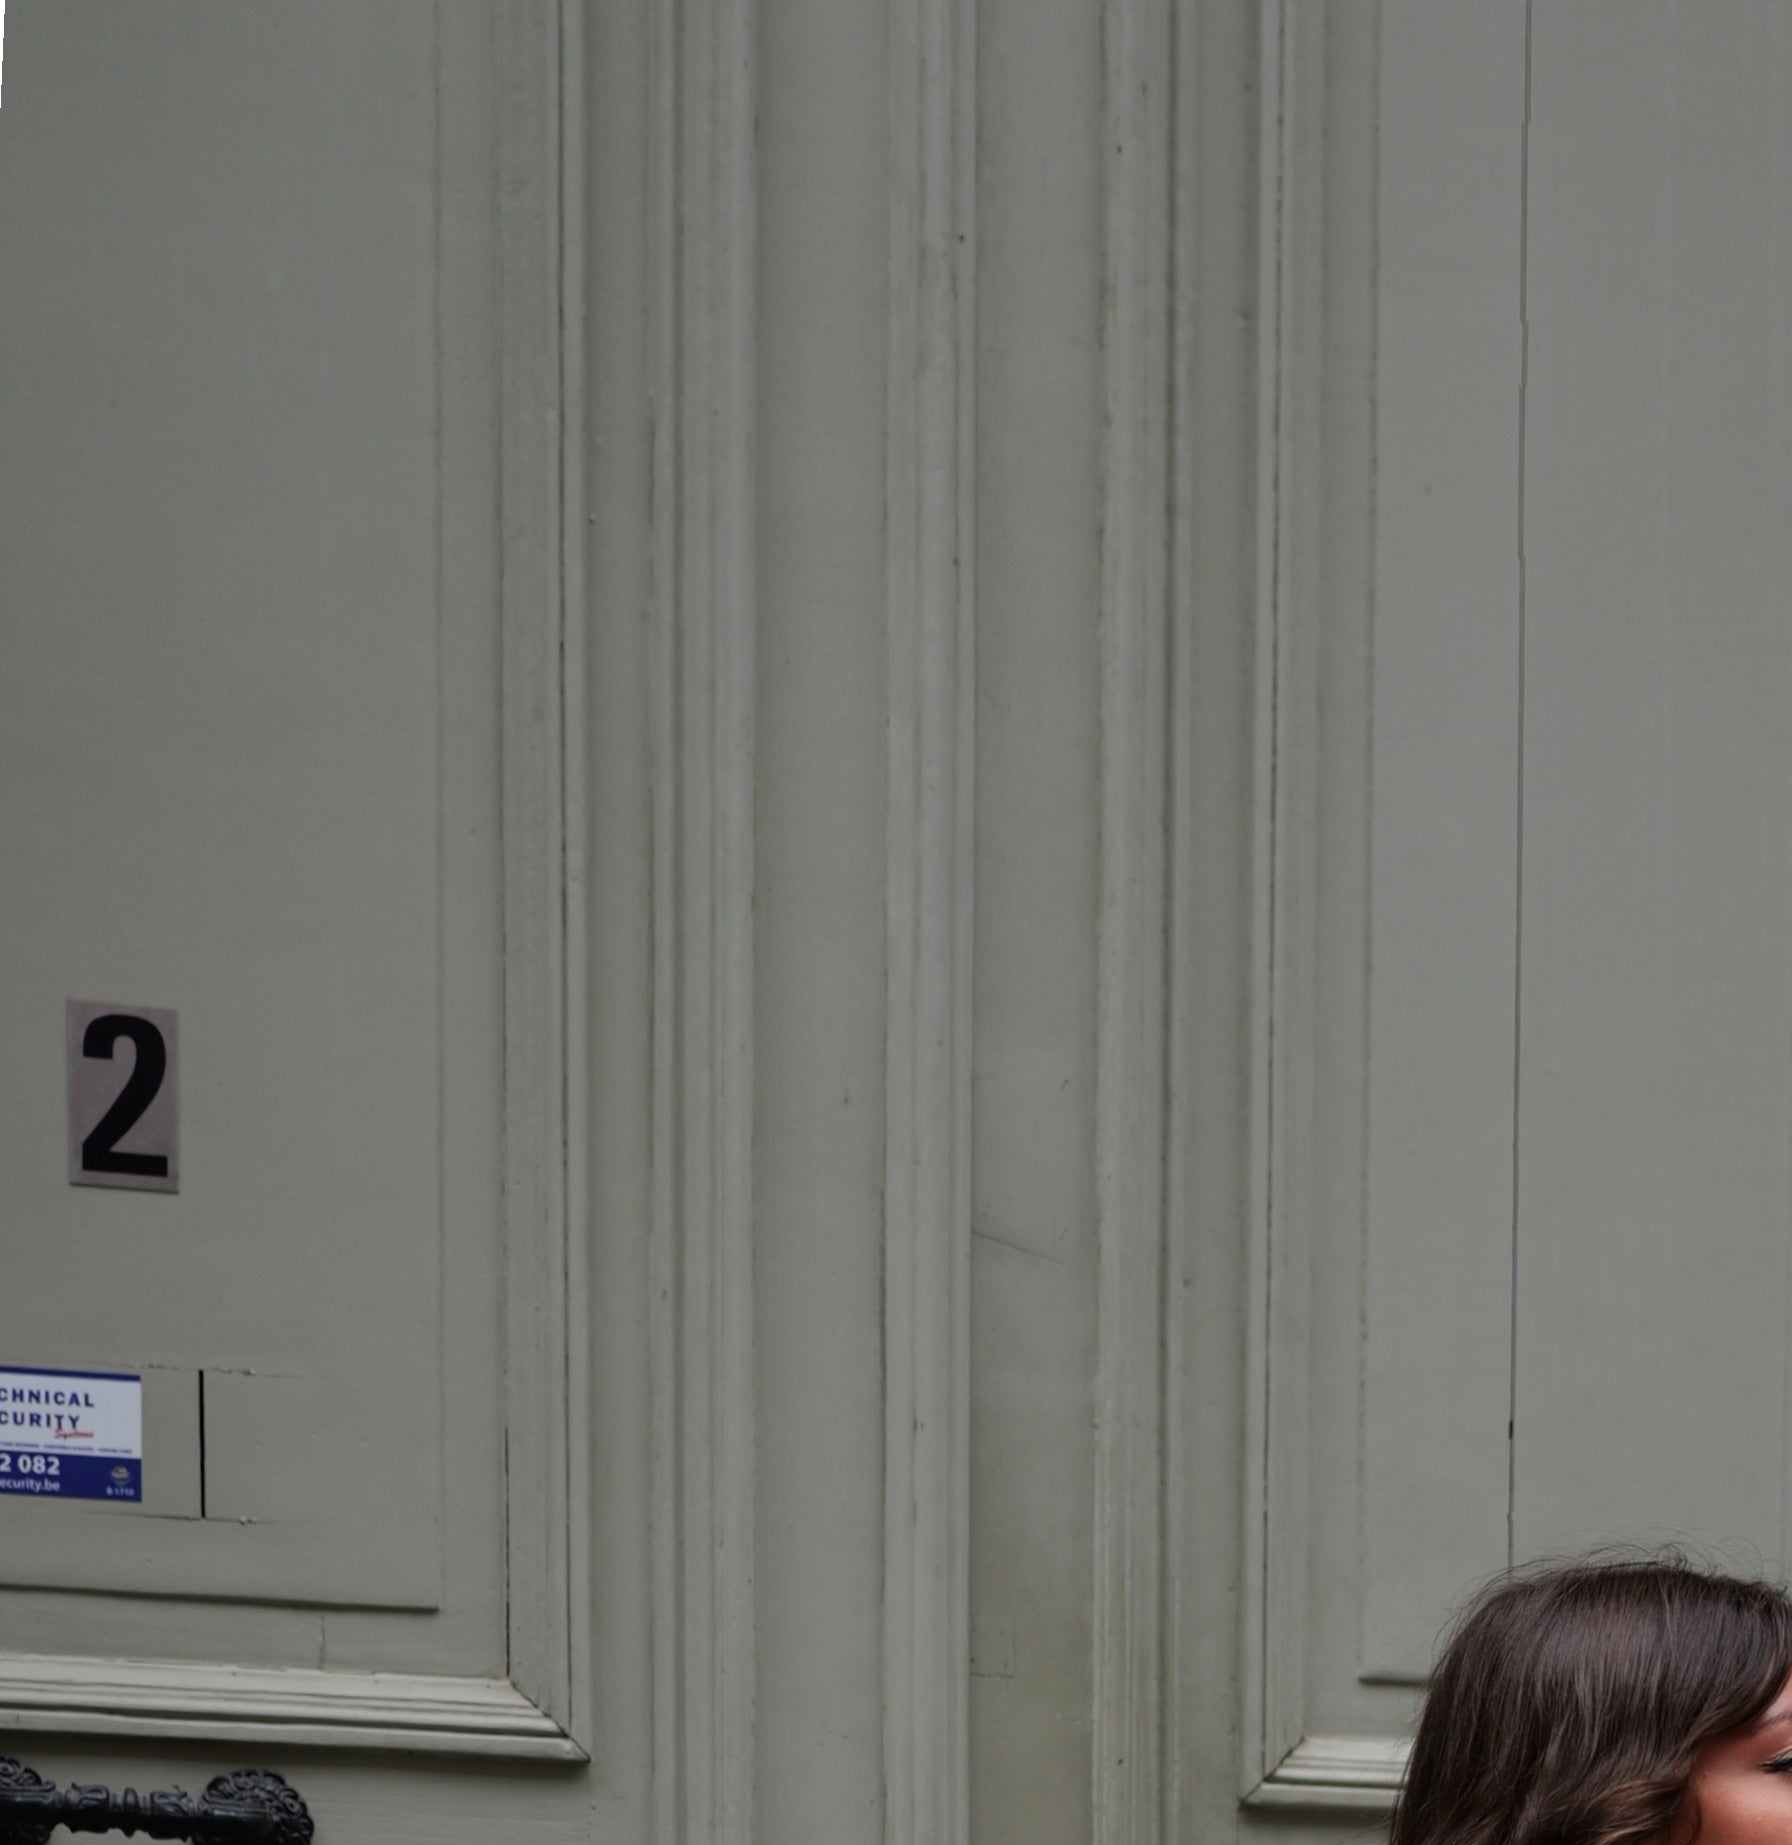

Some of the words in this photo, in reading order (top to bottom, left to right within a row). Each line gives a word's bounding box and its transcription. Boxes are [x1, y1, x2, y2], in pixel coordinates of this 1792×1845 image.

[82, 1014, 168, 1177] 2
[0, 1388, 94, 1407] CHNICAL
[0, 1411, 79, 1429] CURITY
[18, 1455, 60, 1475] 082
